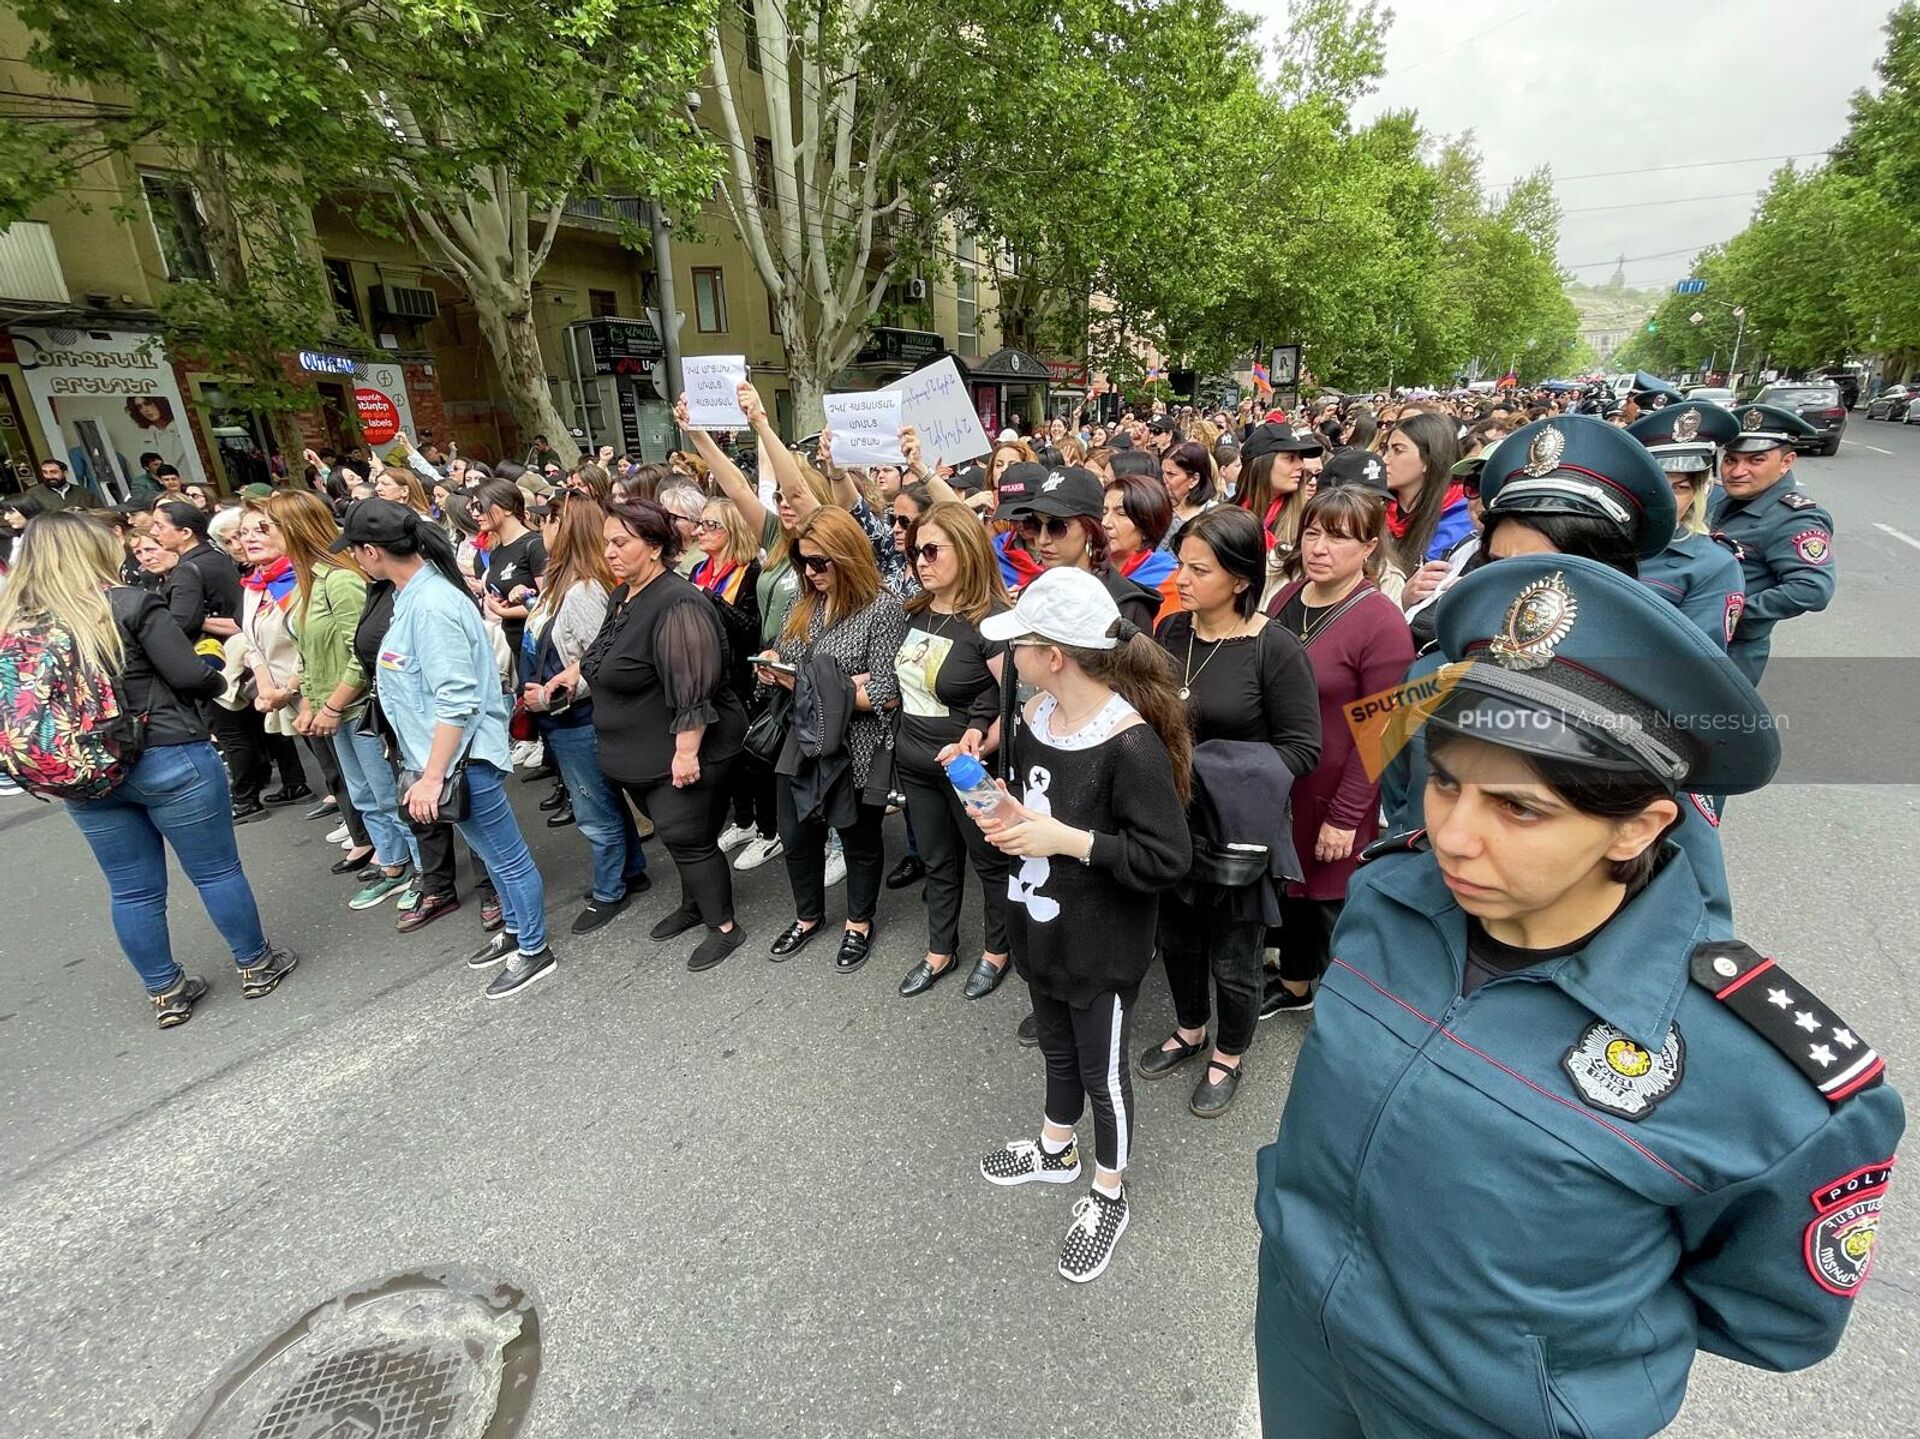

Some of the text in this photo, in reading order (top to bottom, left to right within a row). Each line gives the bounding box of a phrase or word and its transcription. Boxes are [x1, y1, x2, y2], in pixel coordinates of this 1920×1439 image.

[34, 351, 159, 369] ՕՐԻԳԻՆԱԼ
[51, 377, 158, 393] ԲՐԵՆԴԵՐ
[368, 419, 393, 428] labels
